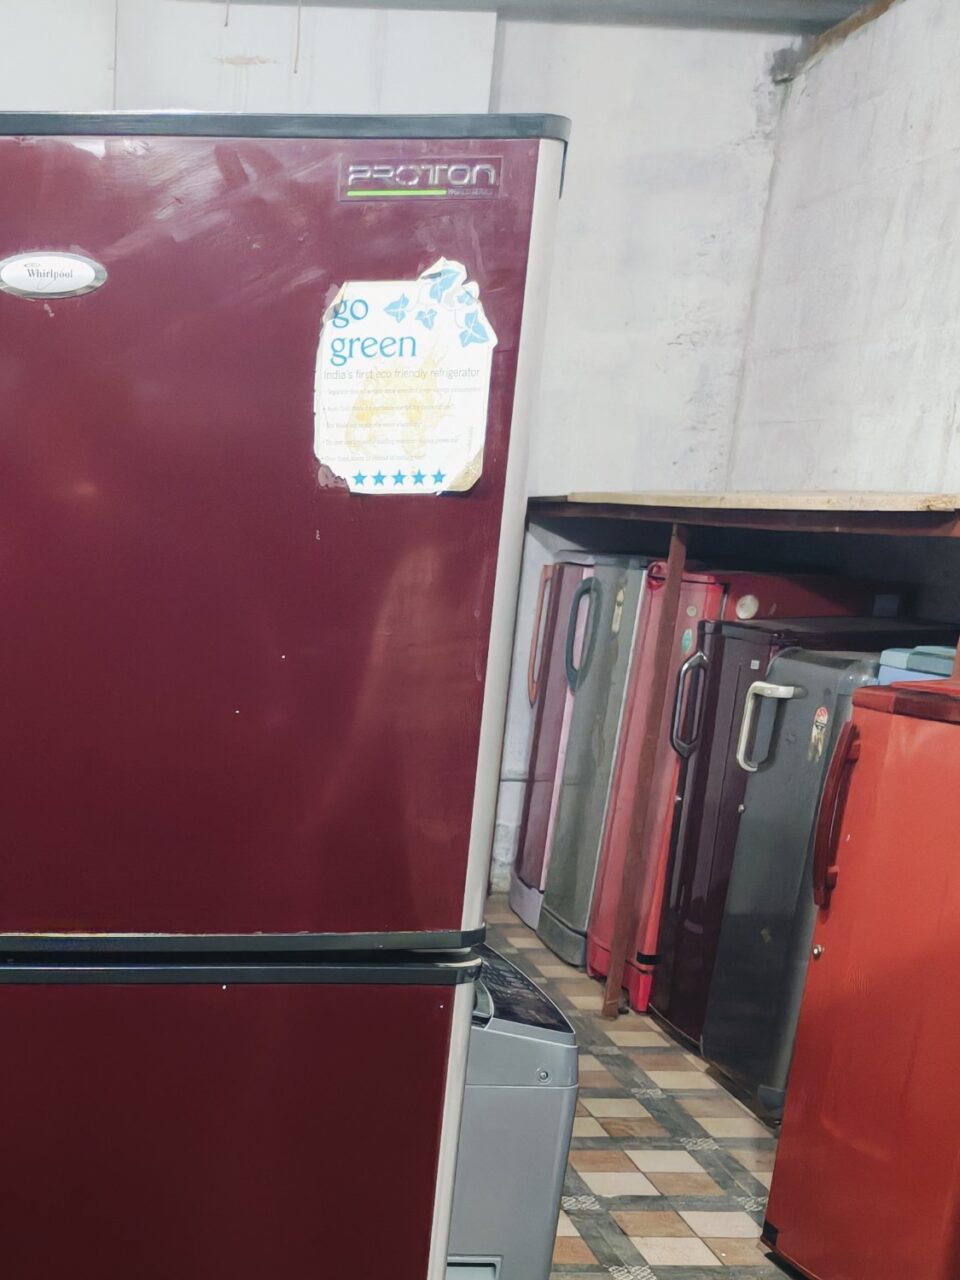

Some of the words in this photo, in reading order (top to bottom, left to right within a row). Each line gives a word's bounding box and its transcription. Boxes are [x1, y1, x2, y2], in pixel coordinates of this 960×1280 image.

[26, 268, 73, 281] Whirlpool
[331, 298, 369, 329] go
[329, 336, 417, 367] green
[323, 369, 353, 380] India's
[356, 369, 373, 379] first
[375, 370, 392, 379] eco
[394, 368, 427, 380] friendly
[430, 367, 481, 380] refrigerator
